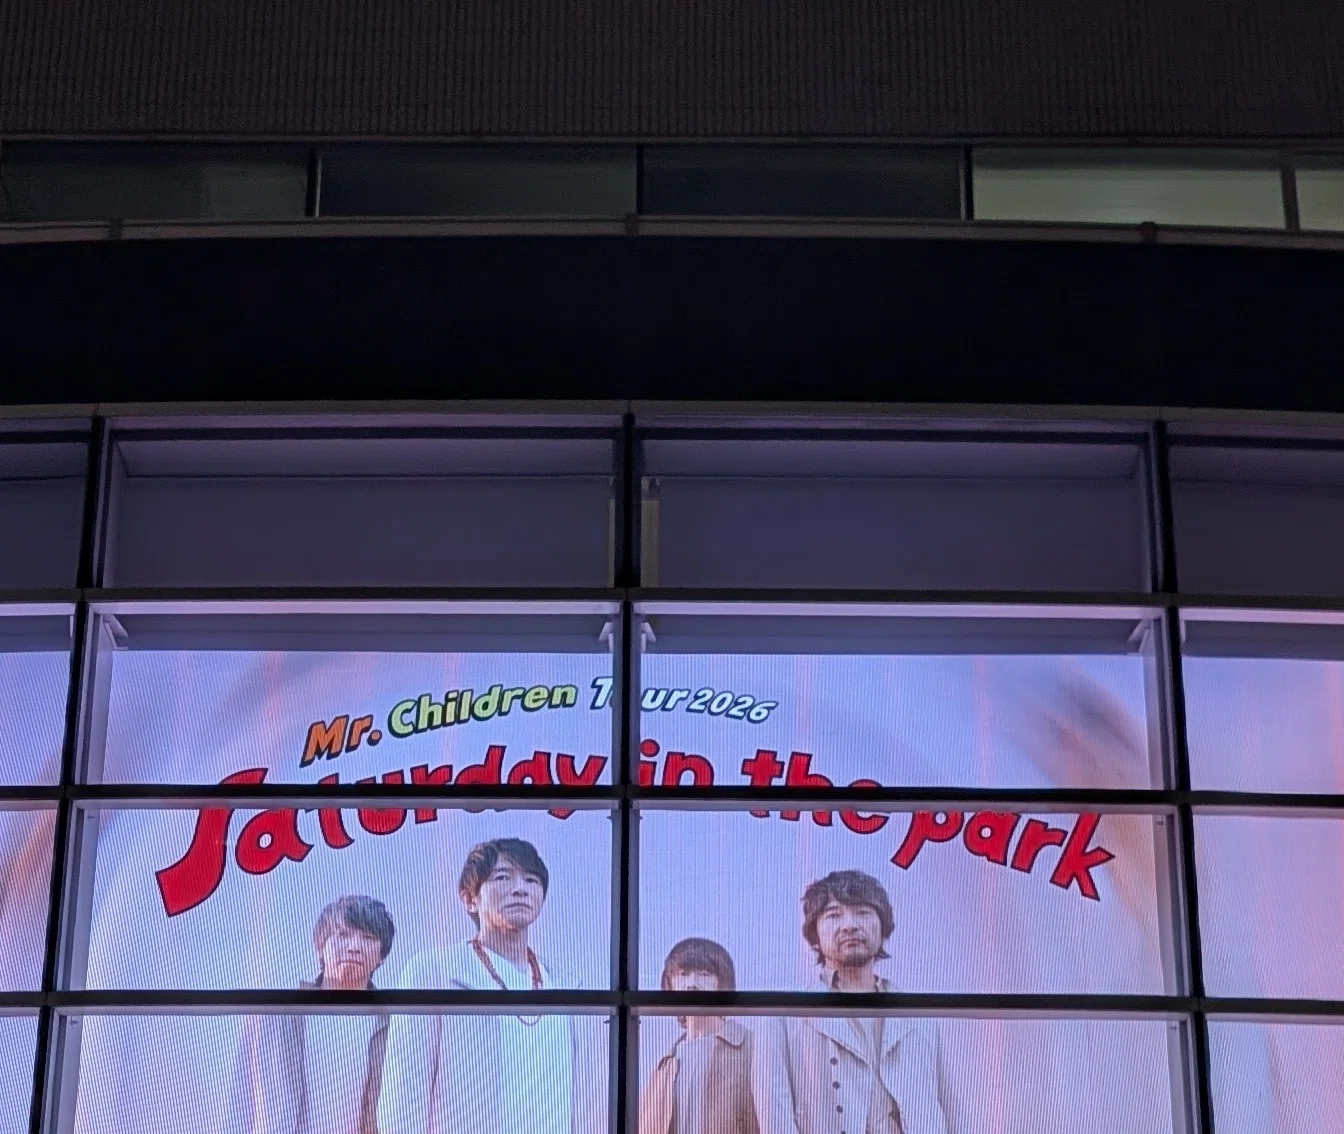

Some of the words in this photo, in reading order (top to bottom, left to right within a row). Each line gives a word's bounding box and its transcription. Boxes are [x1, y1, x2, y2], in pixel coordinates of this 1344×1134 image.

[300, 714, 382, 767] Mr.
[387, 683, 579, 739] Children
[589, 675, 689, 713] Tur
[687, 688, 778, 724] 2026
[155, 745, 608, 917] Saturday
[639, 738, 714, 788] in
[741, 748, 889, 834] the
[891, 806, 1116, 901] park
